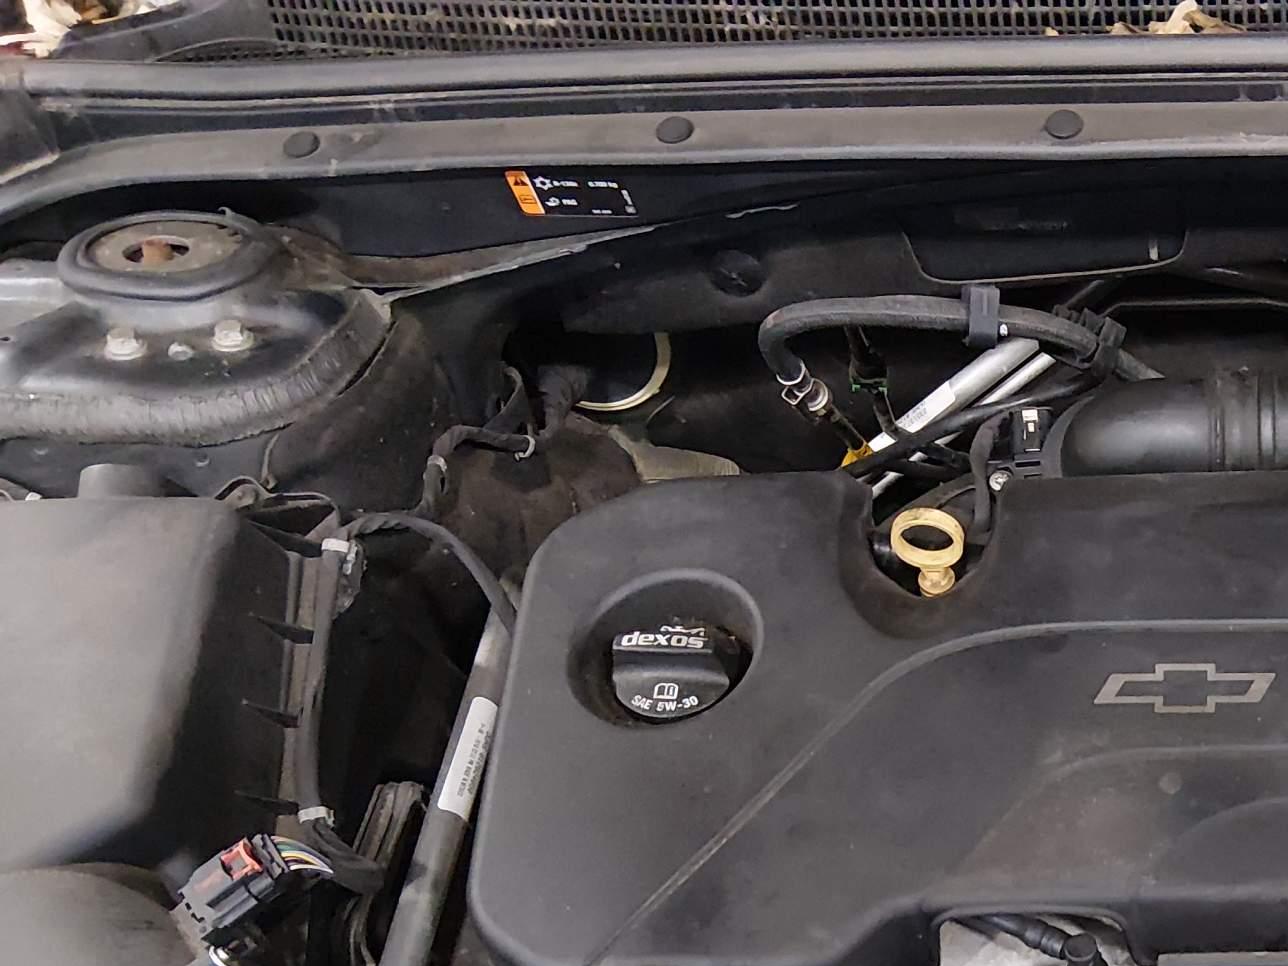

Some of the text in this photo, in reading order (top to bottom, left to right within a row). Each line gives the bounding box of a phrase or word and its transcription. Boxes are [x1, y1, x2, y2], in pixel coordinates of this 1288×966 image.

[620, 631, 709, 649] dexos
[631, 694, 699, 712] SAE 5W-30
